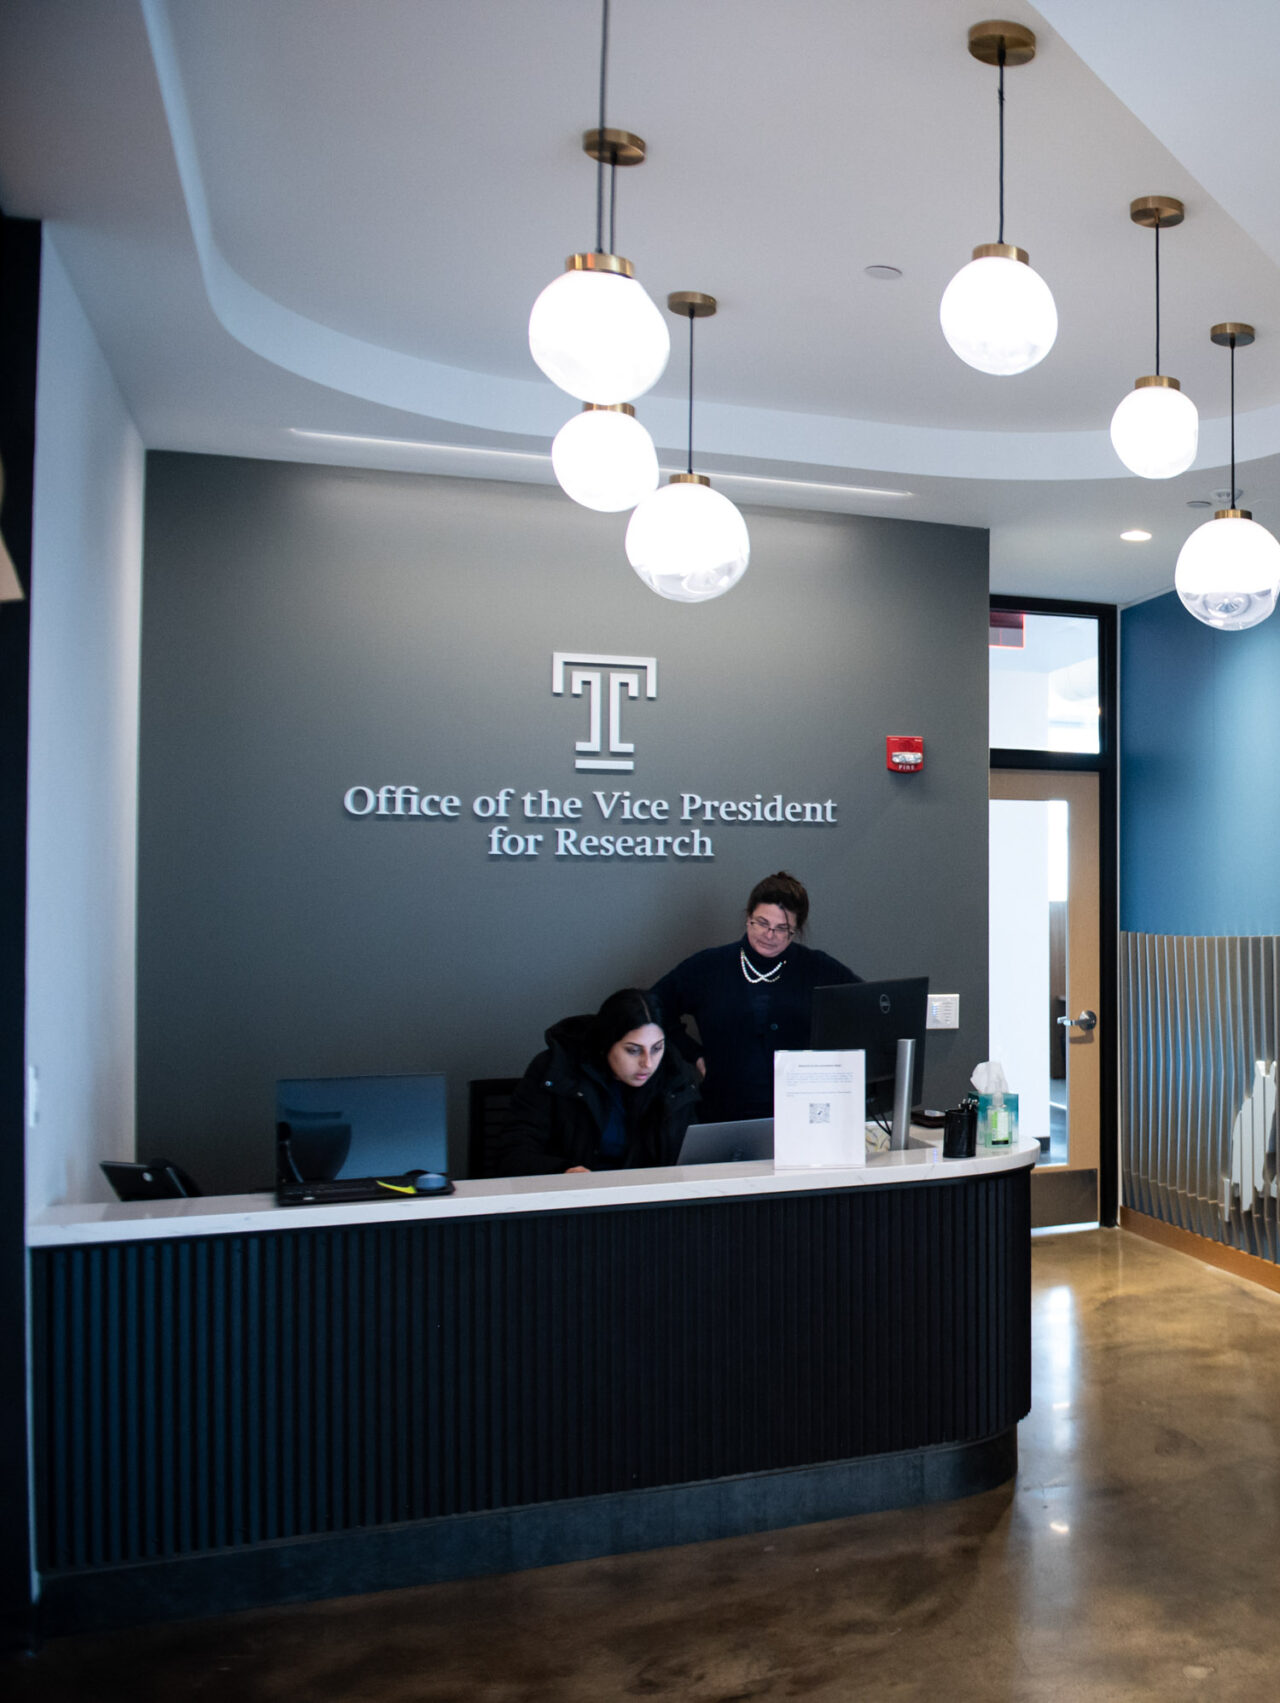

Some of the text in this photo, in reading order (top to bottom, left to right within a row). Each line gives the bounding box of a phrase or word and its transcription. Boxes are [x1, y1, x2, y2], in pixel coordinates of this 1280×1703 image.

[343, 785, 838, 823] Office of the Vice President
[488, 826, 715, 857] for Research
